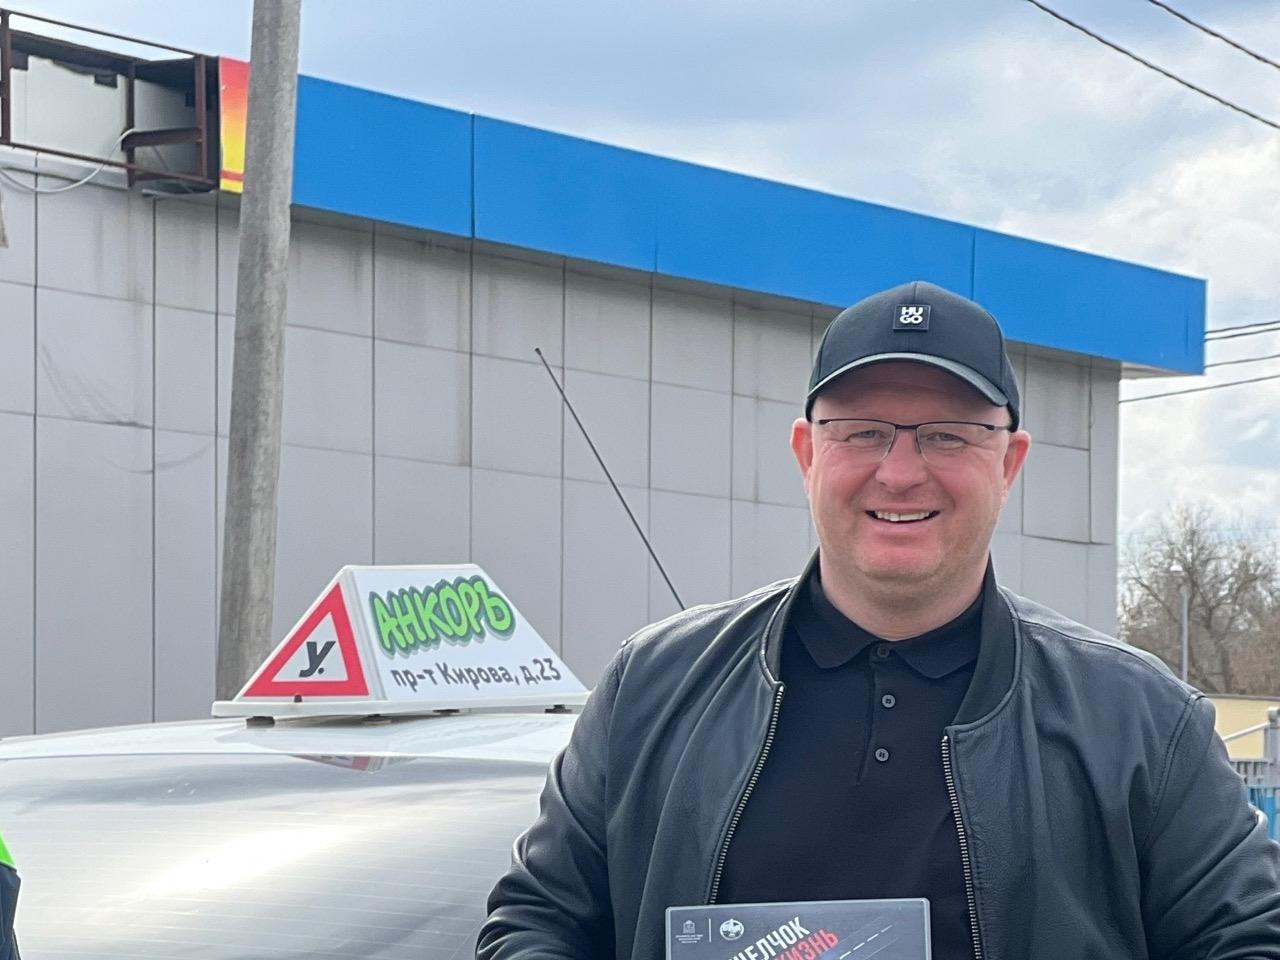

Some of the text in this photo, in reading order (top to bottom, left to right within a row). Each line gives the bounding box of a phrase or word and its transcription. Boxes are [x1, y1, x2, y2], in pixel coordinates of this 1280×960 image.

[370, 575, 516, 655] АНКОРЪ
[390, 658, 561, 693] пр-т Кирова, д.23
